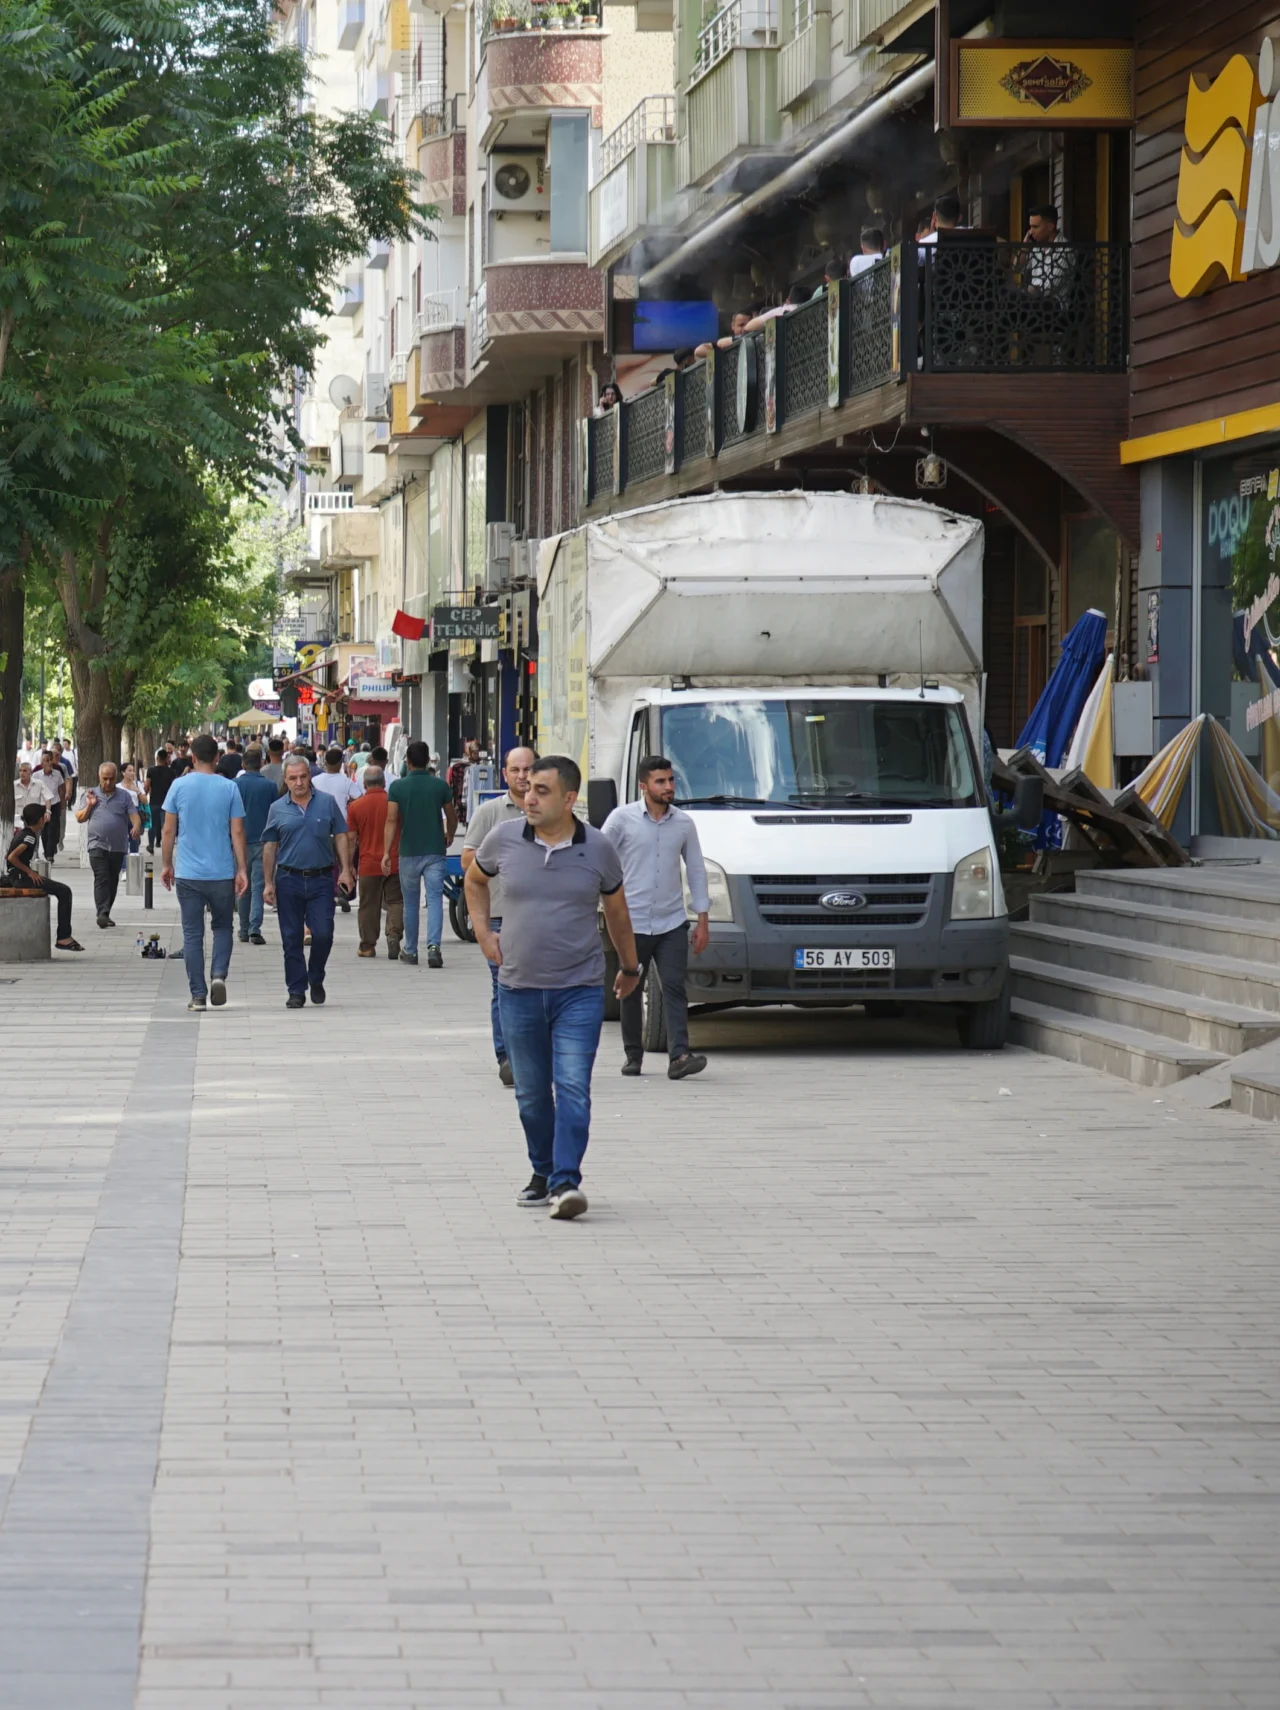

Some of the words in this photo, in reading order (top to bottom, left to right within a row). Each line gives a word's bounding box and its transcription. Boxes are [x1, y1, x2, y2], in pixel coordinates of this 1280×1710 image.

[450, 608, 482, 622] CEP
[434, 621, 499, 637] TEKNİK
[362, 684, 398, 693] PHILIPS
[832, 895, 856, 905] Ford
[806, 951, 825, 966] 56
[834, 951, 852, 966] AY
[862, 951, 890, 966] 509
